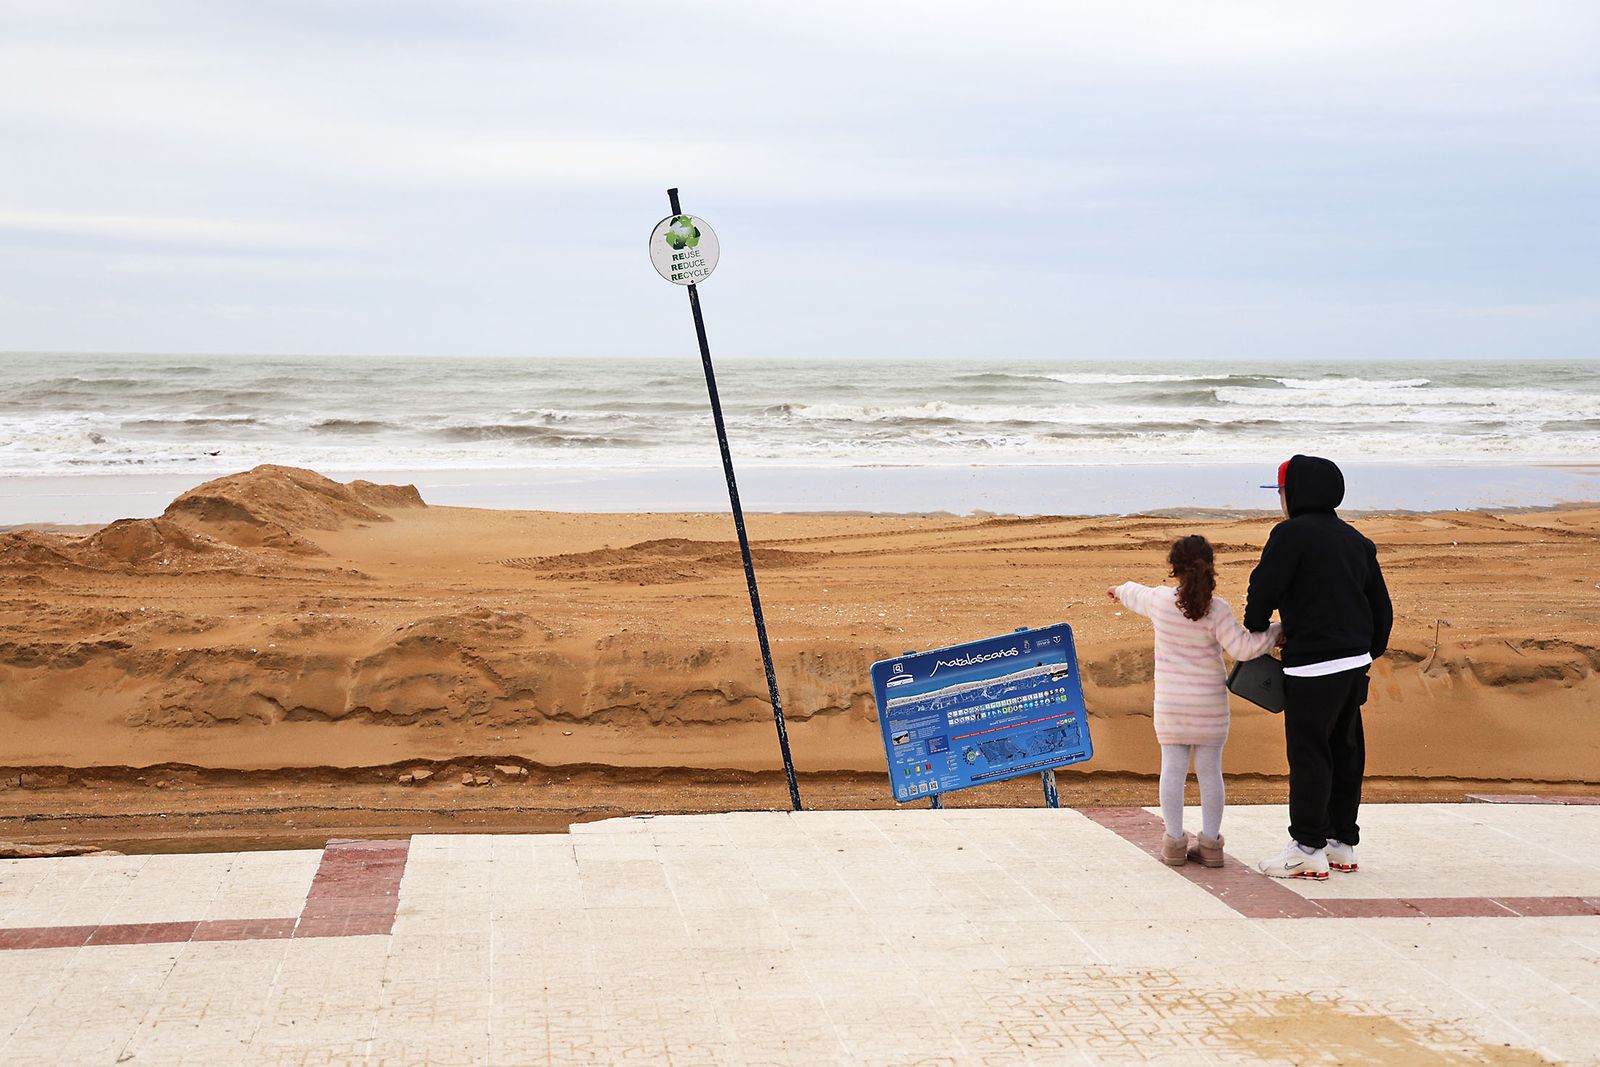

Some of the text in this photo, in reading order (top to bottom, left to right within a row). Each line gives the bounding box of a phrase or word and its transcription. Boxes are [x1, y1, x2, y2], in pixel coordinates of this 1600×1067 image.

[672, 250, 700, 261] REUSE
[671, 259, 705, 271] REDUCE
[671, 268, 709, 281] RECYCLE
